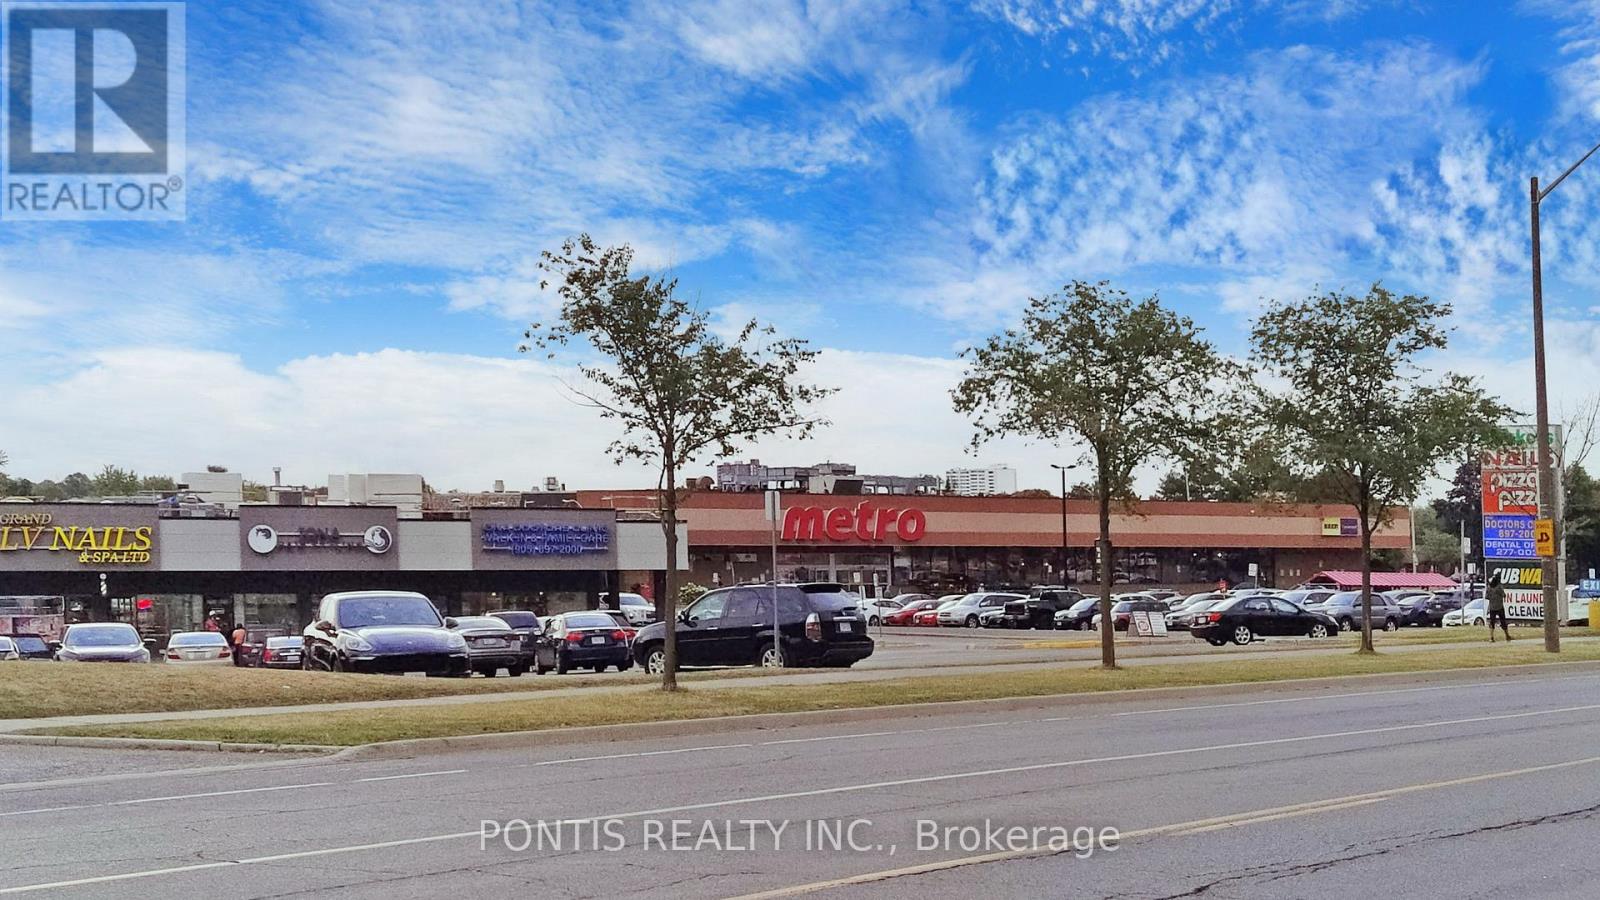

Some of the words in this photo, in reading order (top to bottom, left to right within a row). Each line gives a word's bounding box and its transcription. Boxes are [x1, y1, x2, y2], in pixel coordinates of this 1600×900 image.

[0, 513, 52, 524] GRAND
[780, 500, 926, 541] metro
[1484, 520, 1525, 528] DOCTORS
[51, 526, 152, 550] NAILS
[79, 551, 91, 563] &
[1508, 606, 1544, 617] CLEANE
